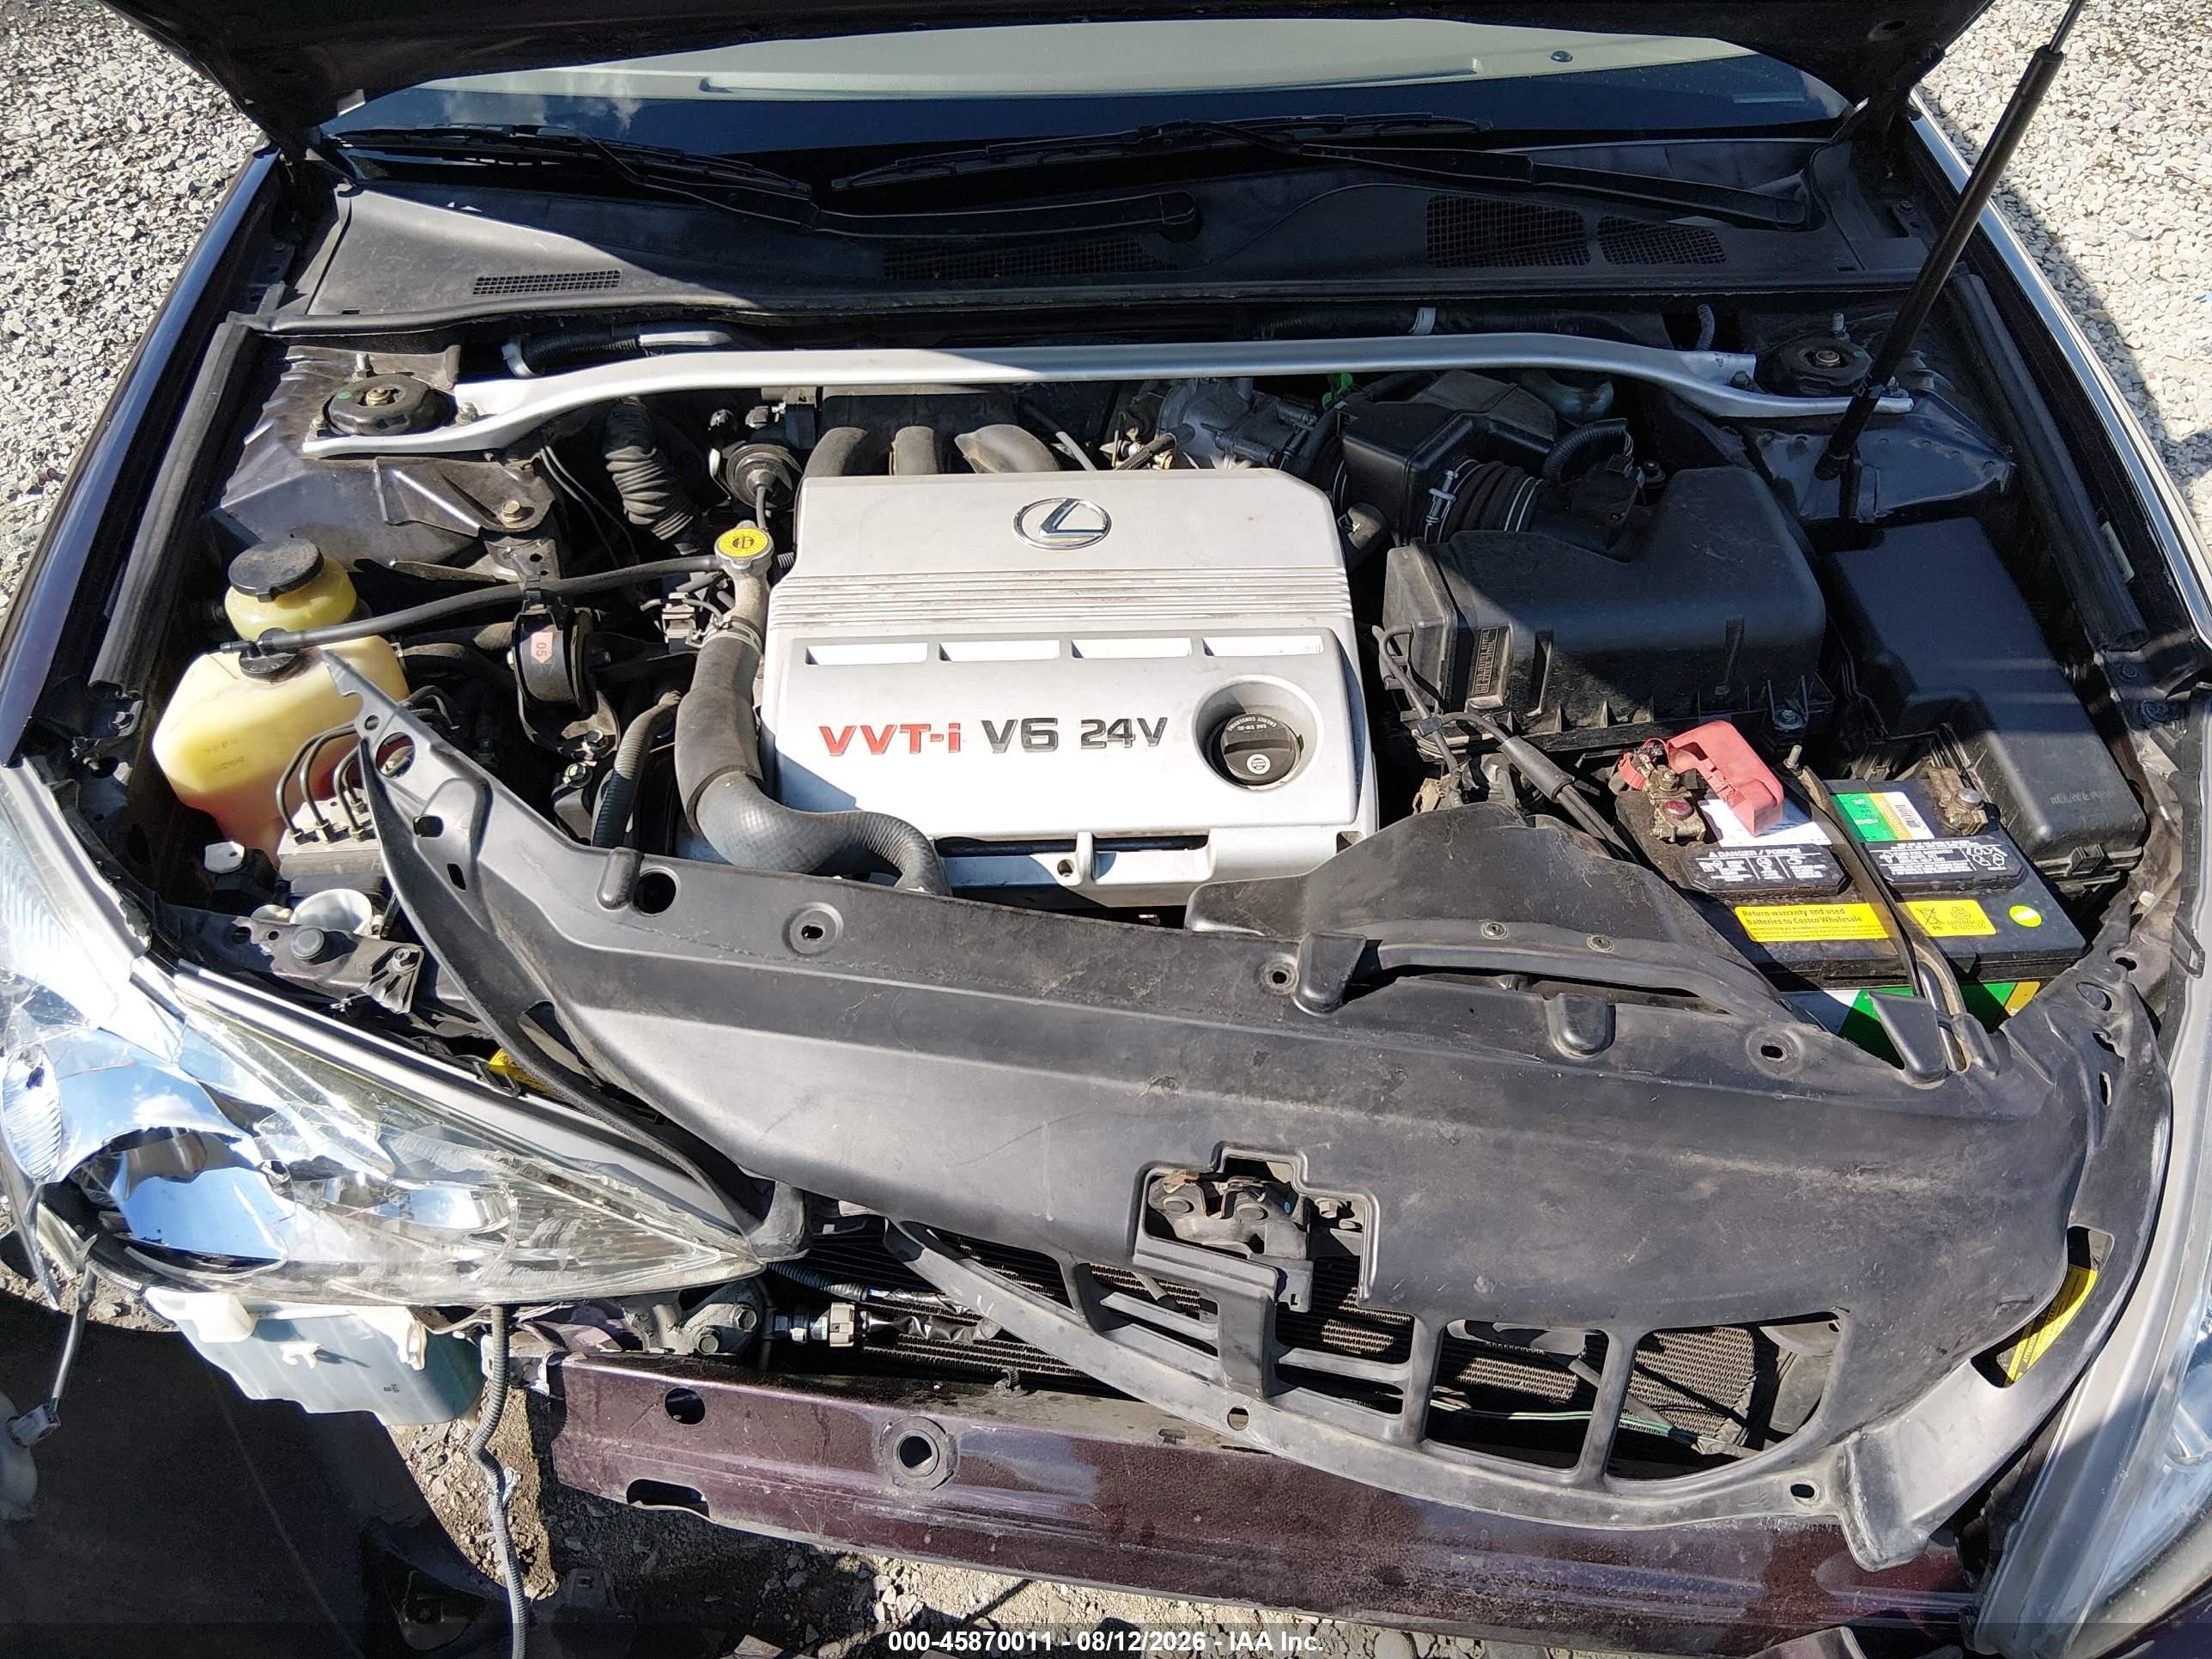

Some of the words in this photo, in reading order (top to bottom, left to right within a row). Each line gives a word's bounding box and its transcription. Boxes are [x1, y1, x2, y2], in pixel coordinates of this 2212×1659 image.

[536, 641, 556, 657] 05
[817, 723, 962, 757] VVT-i
[981, 717, 1059, 754] V6
[1079, 717, 1169, 749] 24V
[1766, 848, 1802, 856] POISON
[1771, 908, 1808, 917] warranty
[1826, 907, 1846, 915] used
[1793, 916, 1820, 925] Costco
[1820, 915, 1863, 924] Wholesale
